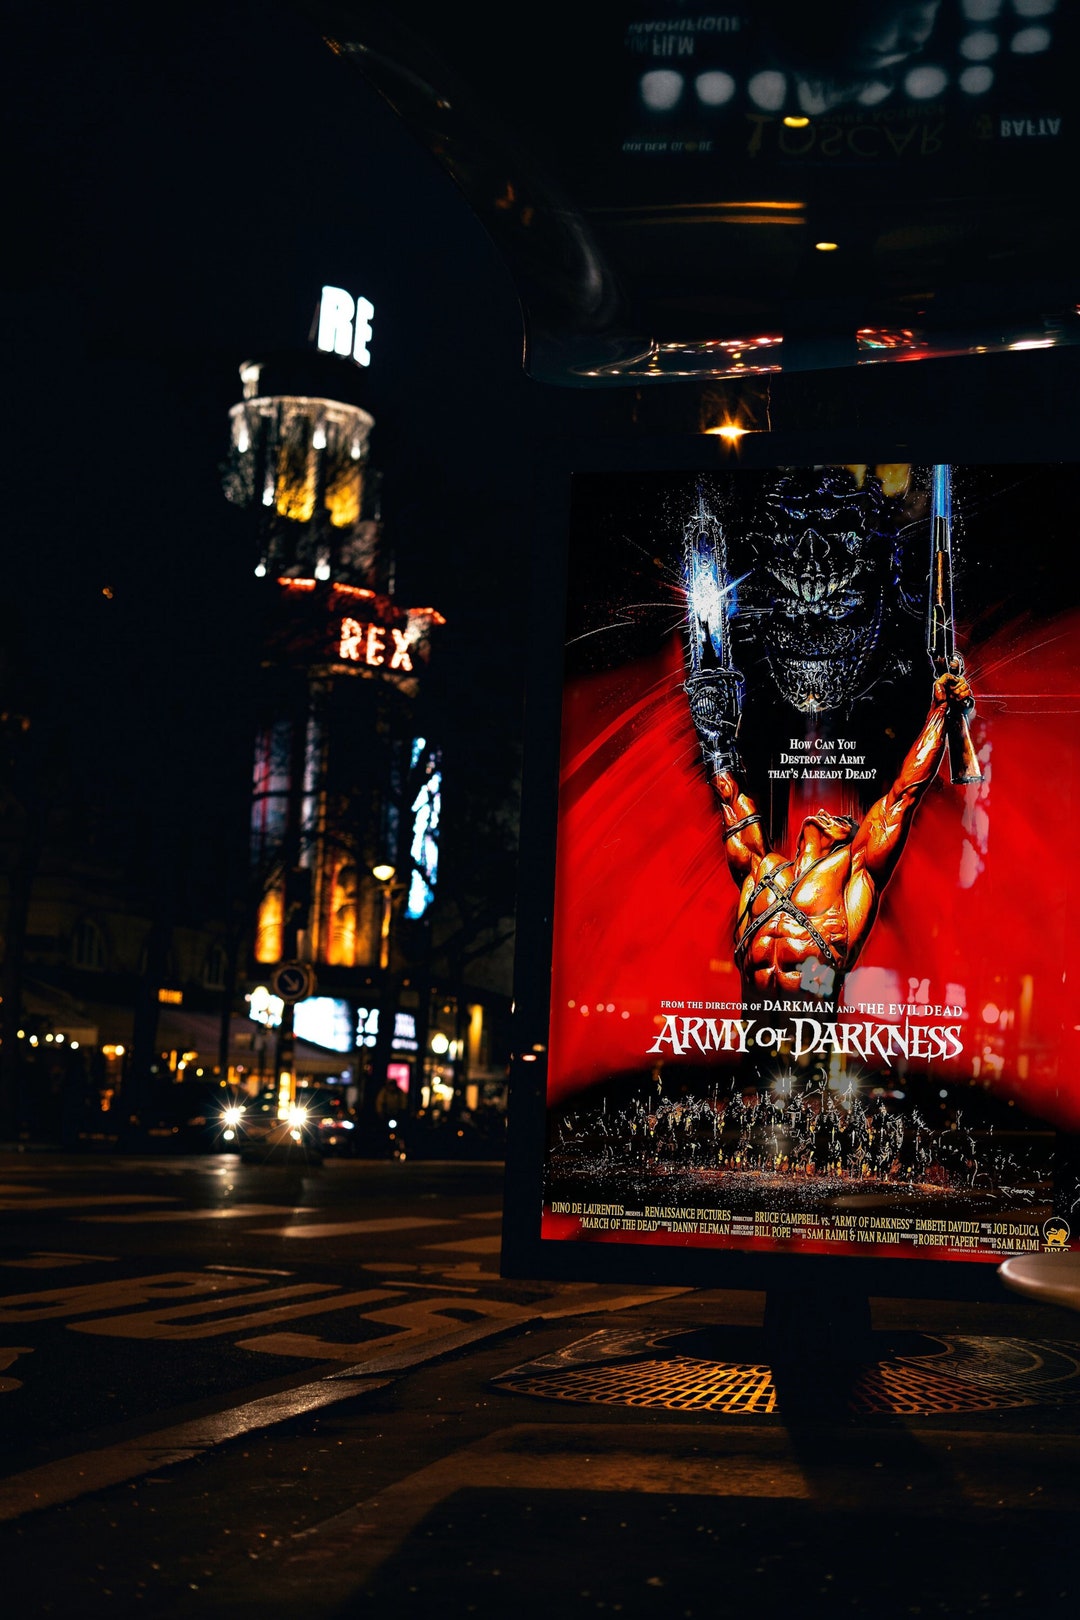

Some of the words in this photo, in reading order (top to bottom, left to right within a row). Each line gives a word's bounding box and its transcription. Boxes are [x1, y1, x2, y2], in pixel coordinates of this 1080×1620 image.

[339, 616, 414, 672] REX
[790, 739, 812, 750] HOW
[815, 739, 834, 749] CAN
[837, 739, 856, 749] YOU
[780, 753, 822, 764] DESTROY
[839, 754, 865, 764] ARMY
[801, 768, 843, 779] ALREADY
[845, 768, 877, 779] DEAD?
[661, 1000, 685, 1008] FROM
[687, 1001, 703, 1009] THE
[705, 1001, 748, 1010] DIRECTOR
[764, 1000, 833, 1013] DARKMAN
[836, 1004, 855, 1013] AND
[858, 1003, 884, 1015] THE
[888, 1004, 920, 1016] EVIL
[924, 1004, 963, 1017] DEAD
[647, 1014, 756, 1054] ARMY
[756, 1027, 792, 1050] OF
[790, 1014, 964, 1067] DARKNESS
[552, 1202, 570, 1213] DINO
[572, 1203, 582, 1214] DE
[645, 1206, 695, 1219] RENAISSANCE
[696, 1209, 731, 1221] PICTURES
[755, 1212, 779, 1223] BRUCE
[781, 1213, 820, 1225] CAMPBELL
[859, 1216, 869, 1228] OF
[915, 1219, 946, 1231] EMBETH
[948, 1222, 979, 1233] DAVIDTZ
[993, 1223, 1007, 1235] JOE
[610, 1218, 620, 1229] OF
[621, 1219, 636, 1230] THE
[673, 1222, 698, 1233] DANNY
[700, 1223, 730, 1234] ELFMAN
[755, 1226, 770, 1236] BILL
[772, 1227, 791, 1238] POPE
[807, 1228, 823, 1239] SAM
[826, 1229, 848, 1240] RAIMI
[850, 1228, 856, 1241] &
[857, 1230, 875, 1242] IVAN
[877, 1231, 899, 1243] RAIMI
[919, 1234, 949, 1246] ROBERT
[950, 1235, 979, 1247] TAPERT
[997, 1237, 1014, 1250] SAM
[1016, 1239, 1039, 1251] RAIMI
